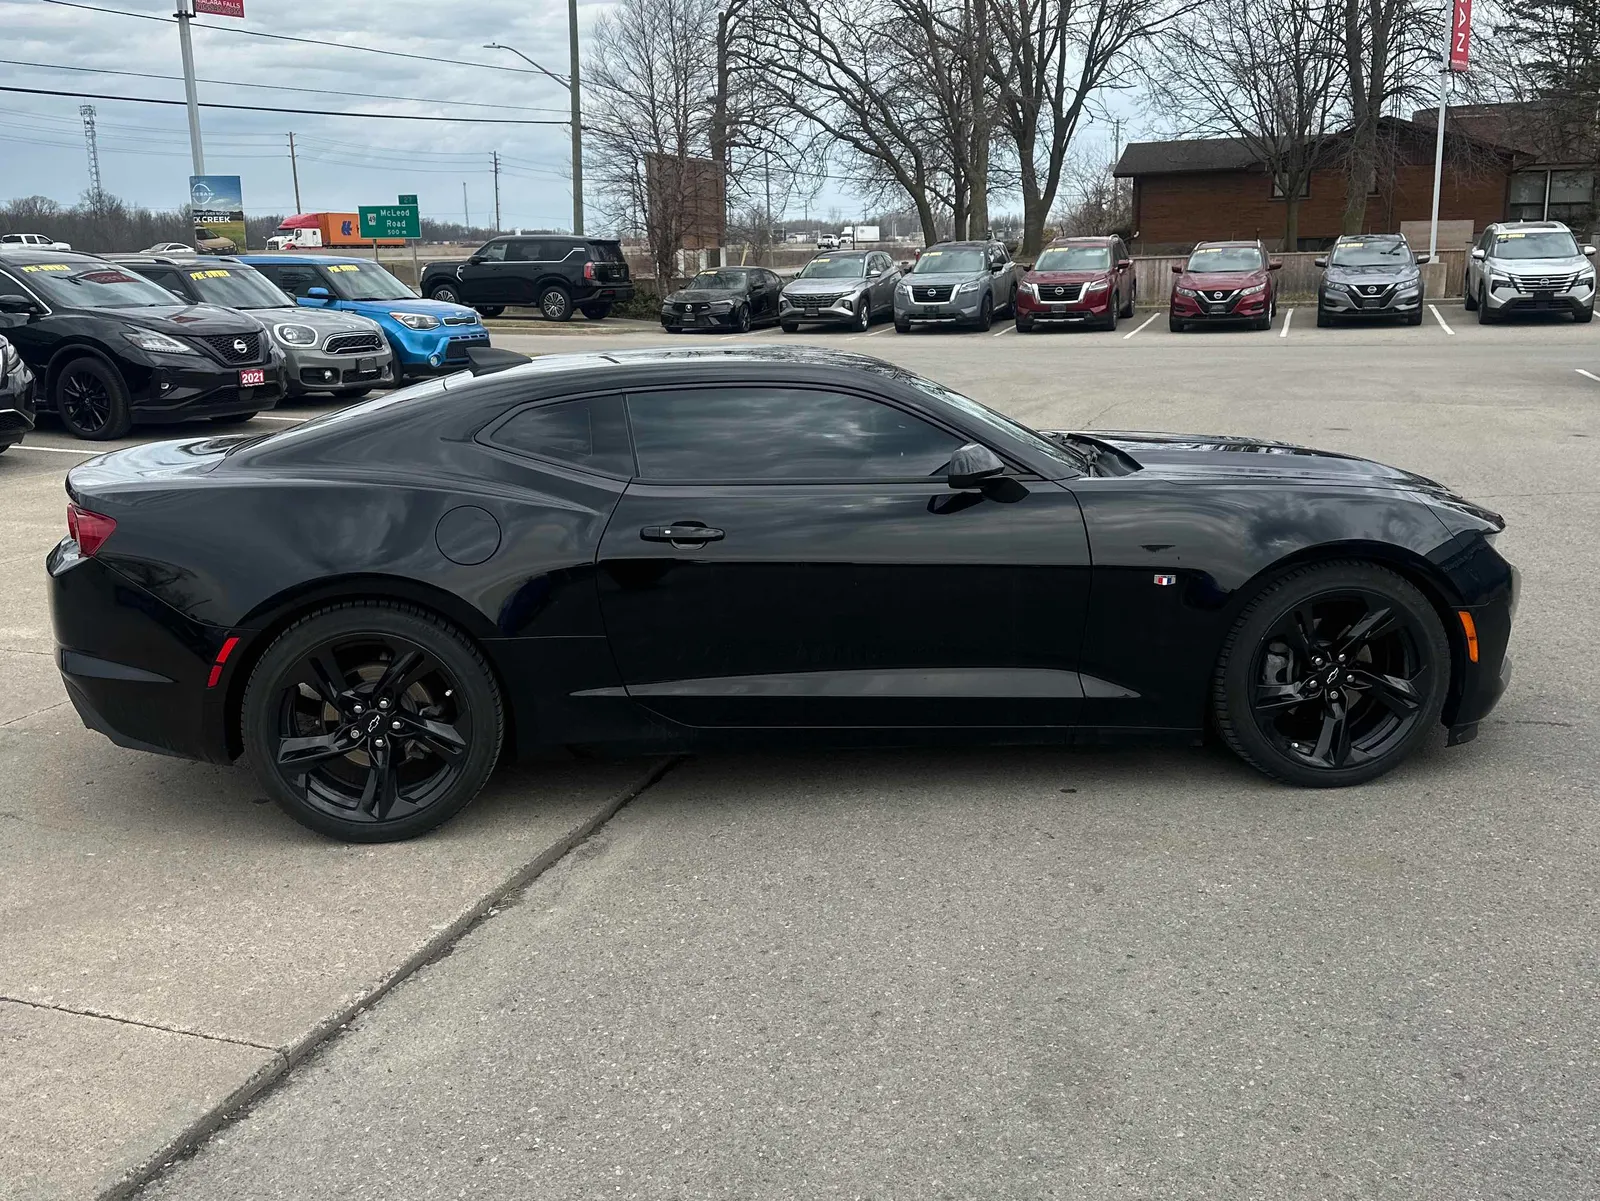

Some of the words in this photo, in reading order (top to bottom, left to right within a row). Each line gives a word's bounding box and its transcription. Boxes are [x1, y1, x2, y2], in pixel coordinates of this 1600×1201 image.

[1456, 0, 1467, 52] AN
[380, 209, 410, 217] McLeod
[386, 220, 406, 228] Road
[242, 371, 264, 384] 2021
